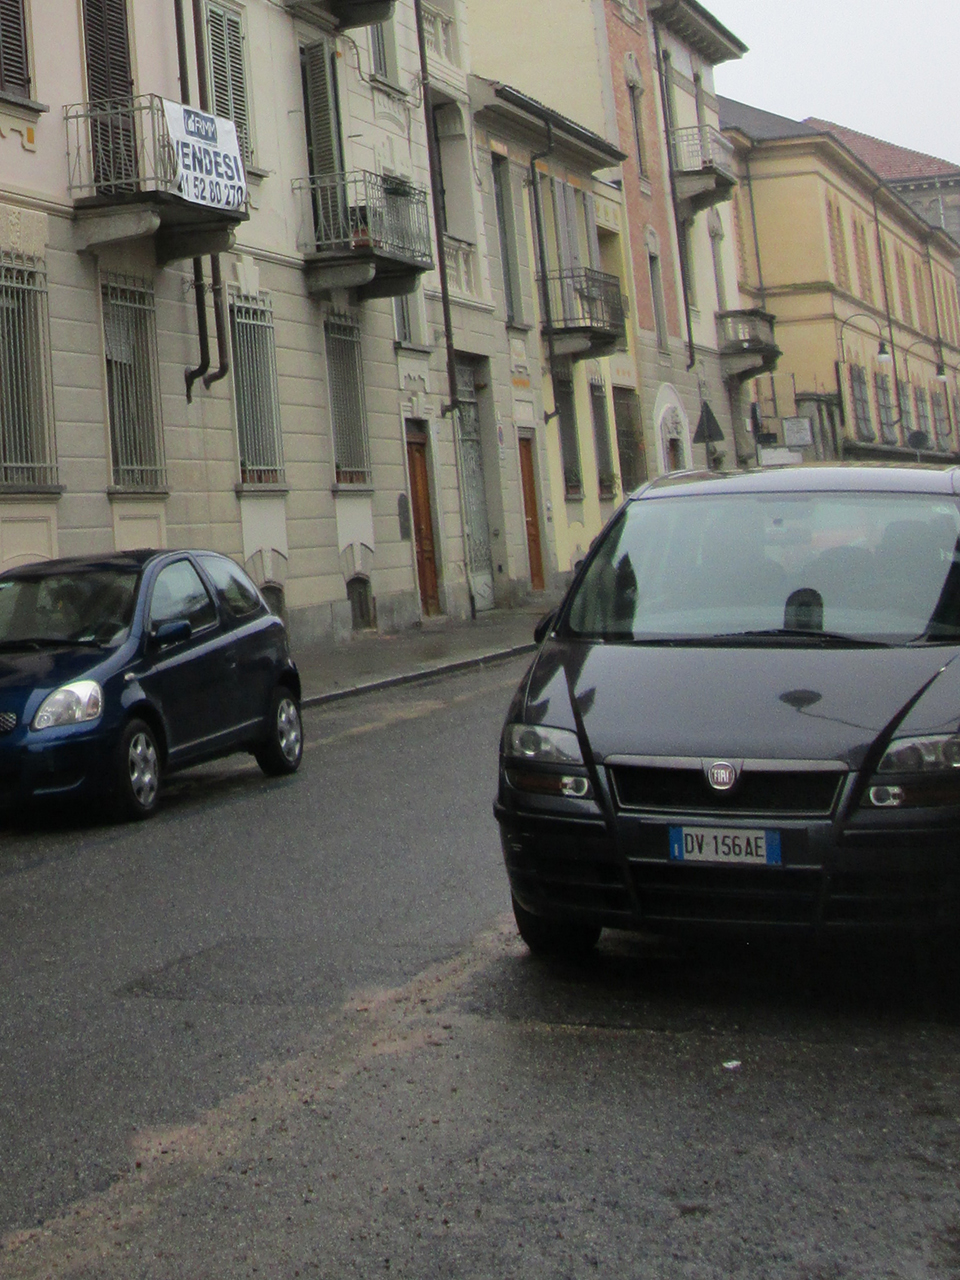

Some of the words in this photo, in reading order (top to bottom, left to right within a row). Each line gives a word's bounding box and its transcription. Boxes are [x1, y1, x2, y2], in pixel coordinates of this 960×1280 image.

[193, 176, 206, 200] 52
[209, 180, 222, 204] 80
[224, 183, 243, 207] 270
[684, 833, 704, 855] DV
